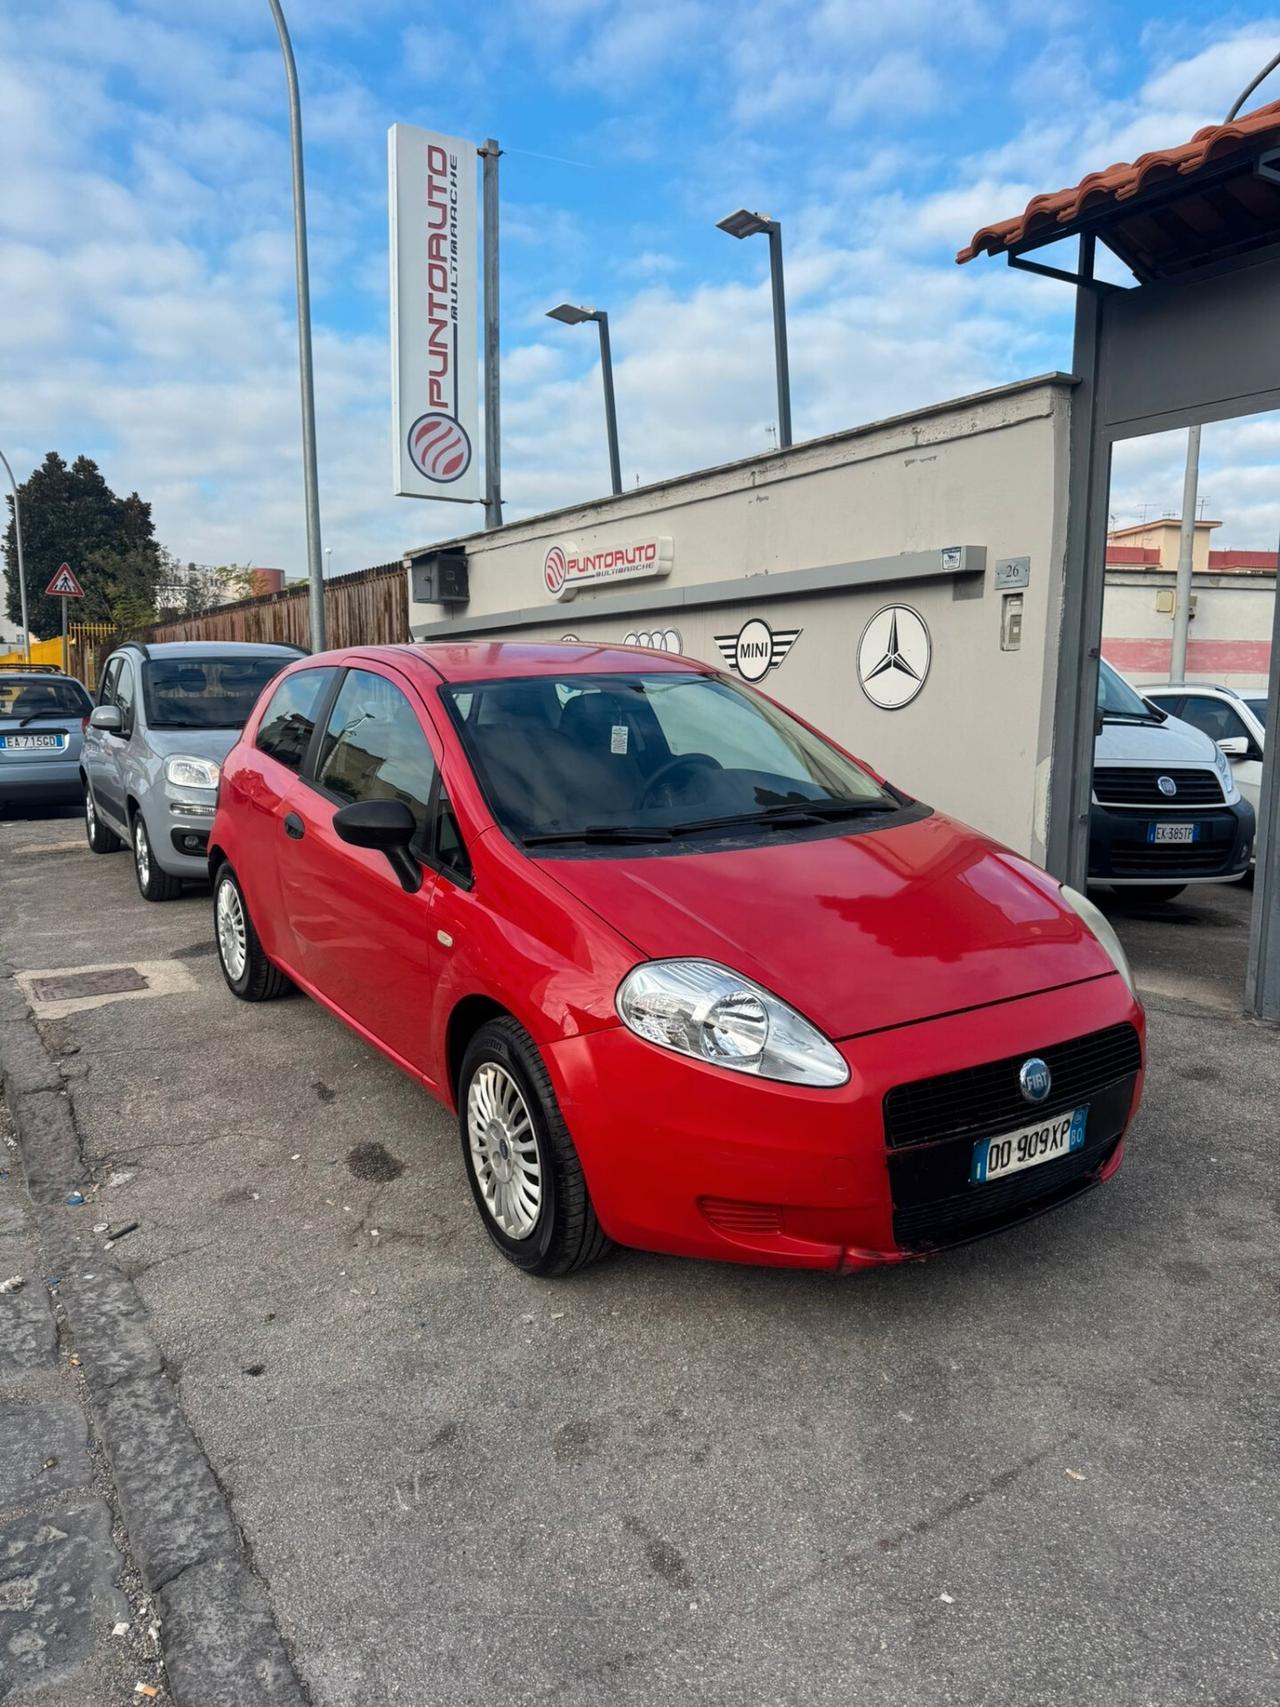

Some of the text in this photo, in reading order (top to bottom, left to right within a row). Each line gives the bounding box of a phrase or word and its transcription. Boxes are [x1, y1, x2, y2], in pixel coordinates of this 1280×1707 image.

[450, 154, 458, 321] MULTIMARCHE
[428, 144, 448, 408] PUNTOAUTO
[567, 543, 656, 574] PUNTOAUTO
[596, 562, 654, 577] MULTIMARCHE
[1006, 564, 1019, 577] 26
[741, 642, 768, 658] MINI
[7, 735, 20, 747] EA
[1026, 1072, 1047, 1091] FIAT
[988, 1141, 1012, 1172] DD
[1017, 1119, 1071, 1162] 909XP
